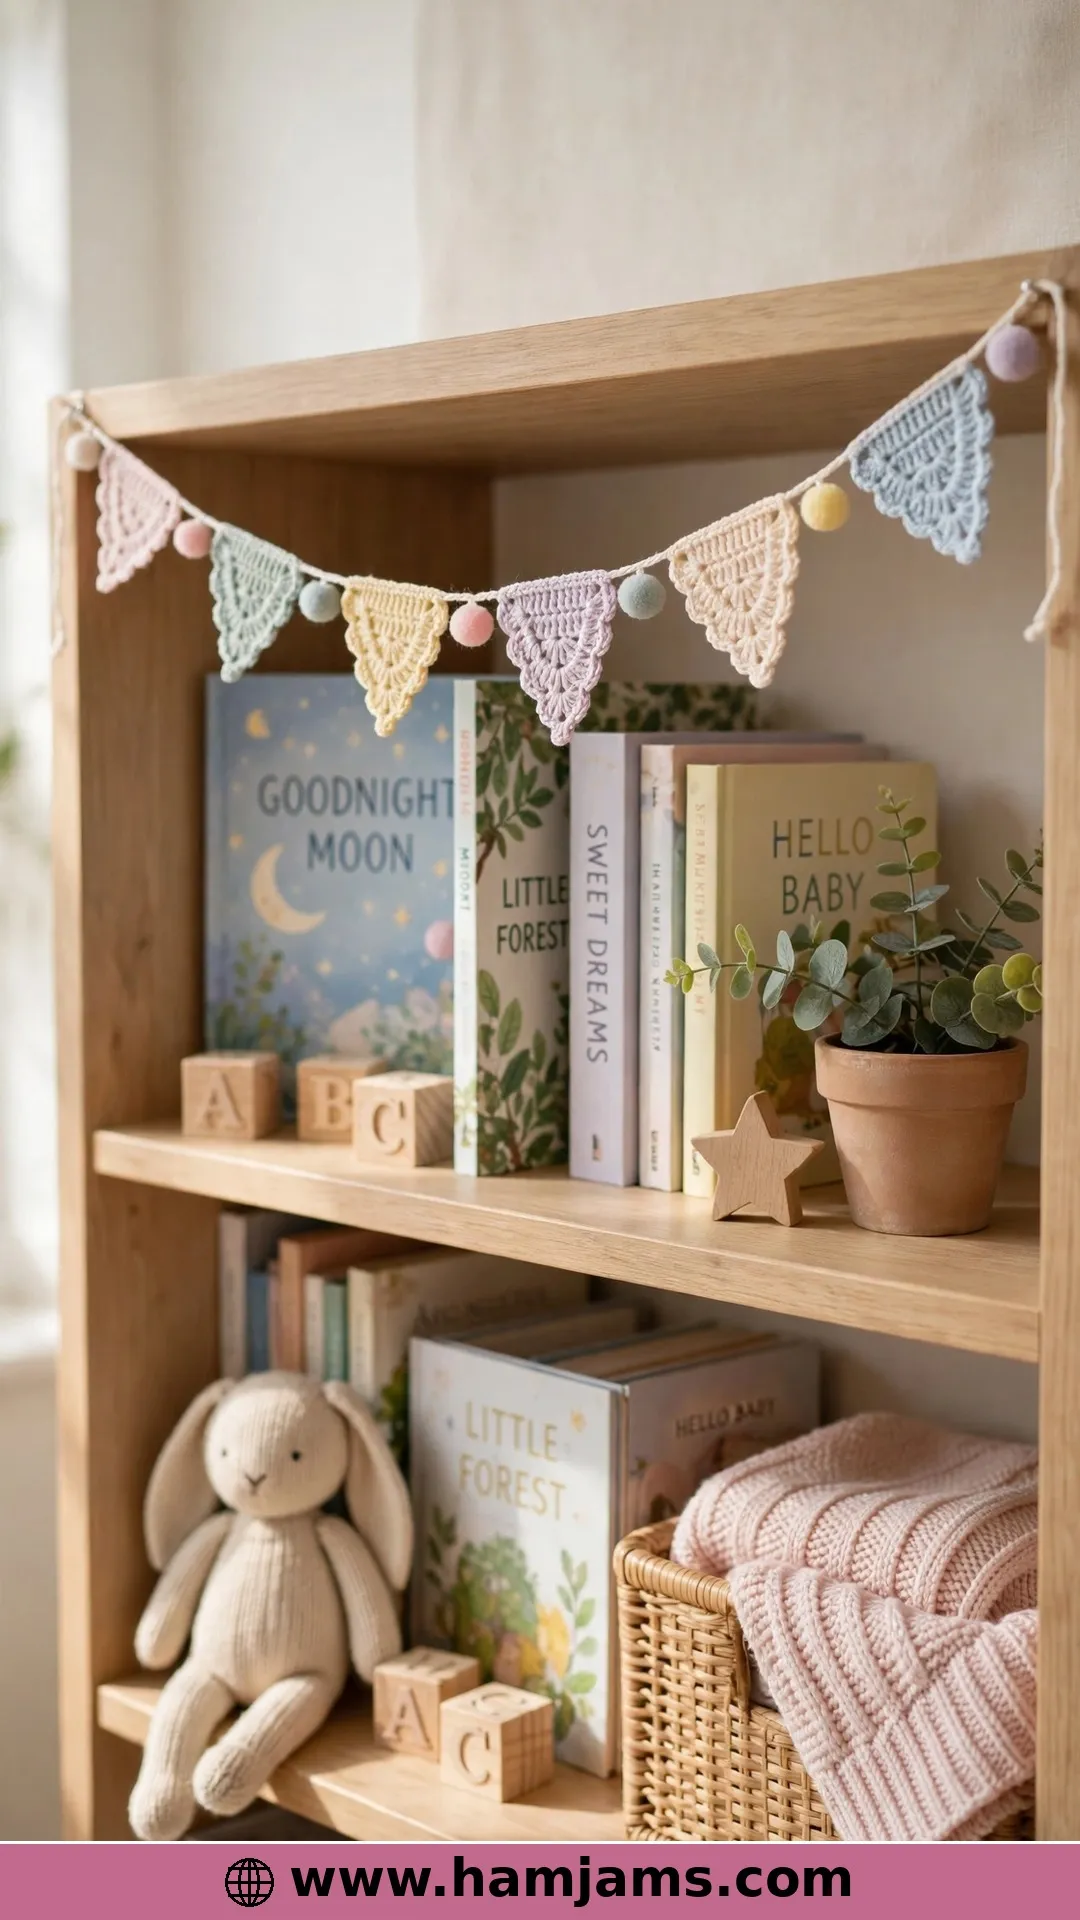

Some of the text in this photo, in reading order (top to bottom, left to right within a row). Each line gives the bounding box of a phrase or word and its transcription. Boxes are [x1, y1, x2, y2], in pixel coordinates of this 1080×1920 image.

[257, 774, 454, 818] GOODNIGHT
[307, 831, 414, 874] MOON
[773, 817, 874, 858] HELLO
[503, 874, 568, 908] LITTLE
[782, 872, 865, 915] BABY
[497, 920, 569, 955] FOREST
[586, 824, 608, 1063] SWEET DREAMS
[195, 1069, 248, 1132] A
[309, 1074, 353, 1131] B
[364, 1095, 407, 1156] C
[465, 1400, 558, 1462] LITTLE
[675, 1406, 728, 1438] HELLO
[459, 1452, 567, 1521] FOREST
[382, 1684, 434, 1752] A
[449, 1725, 492, 1787] C
